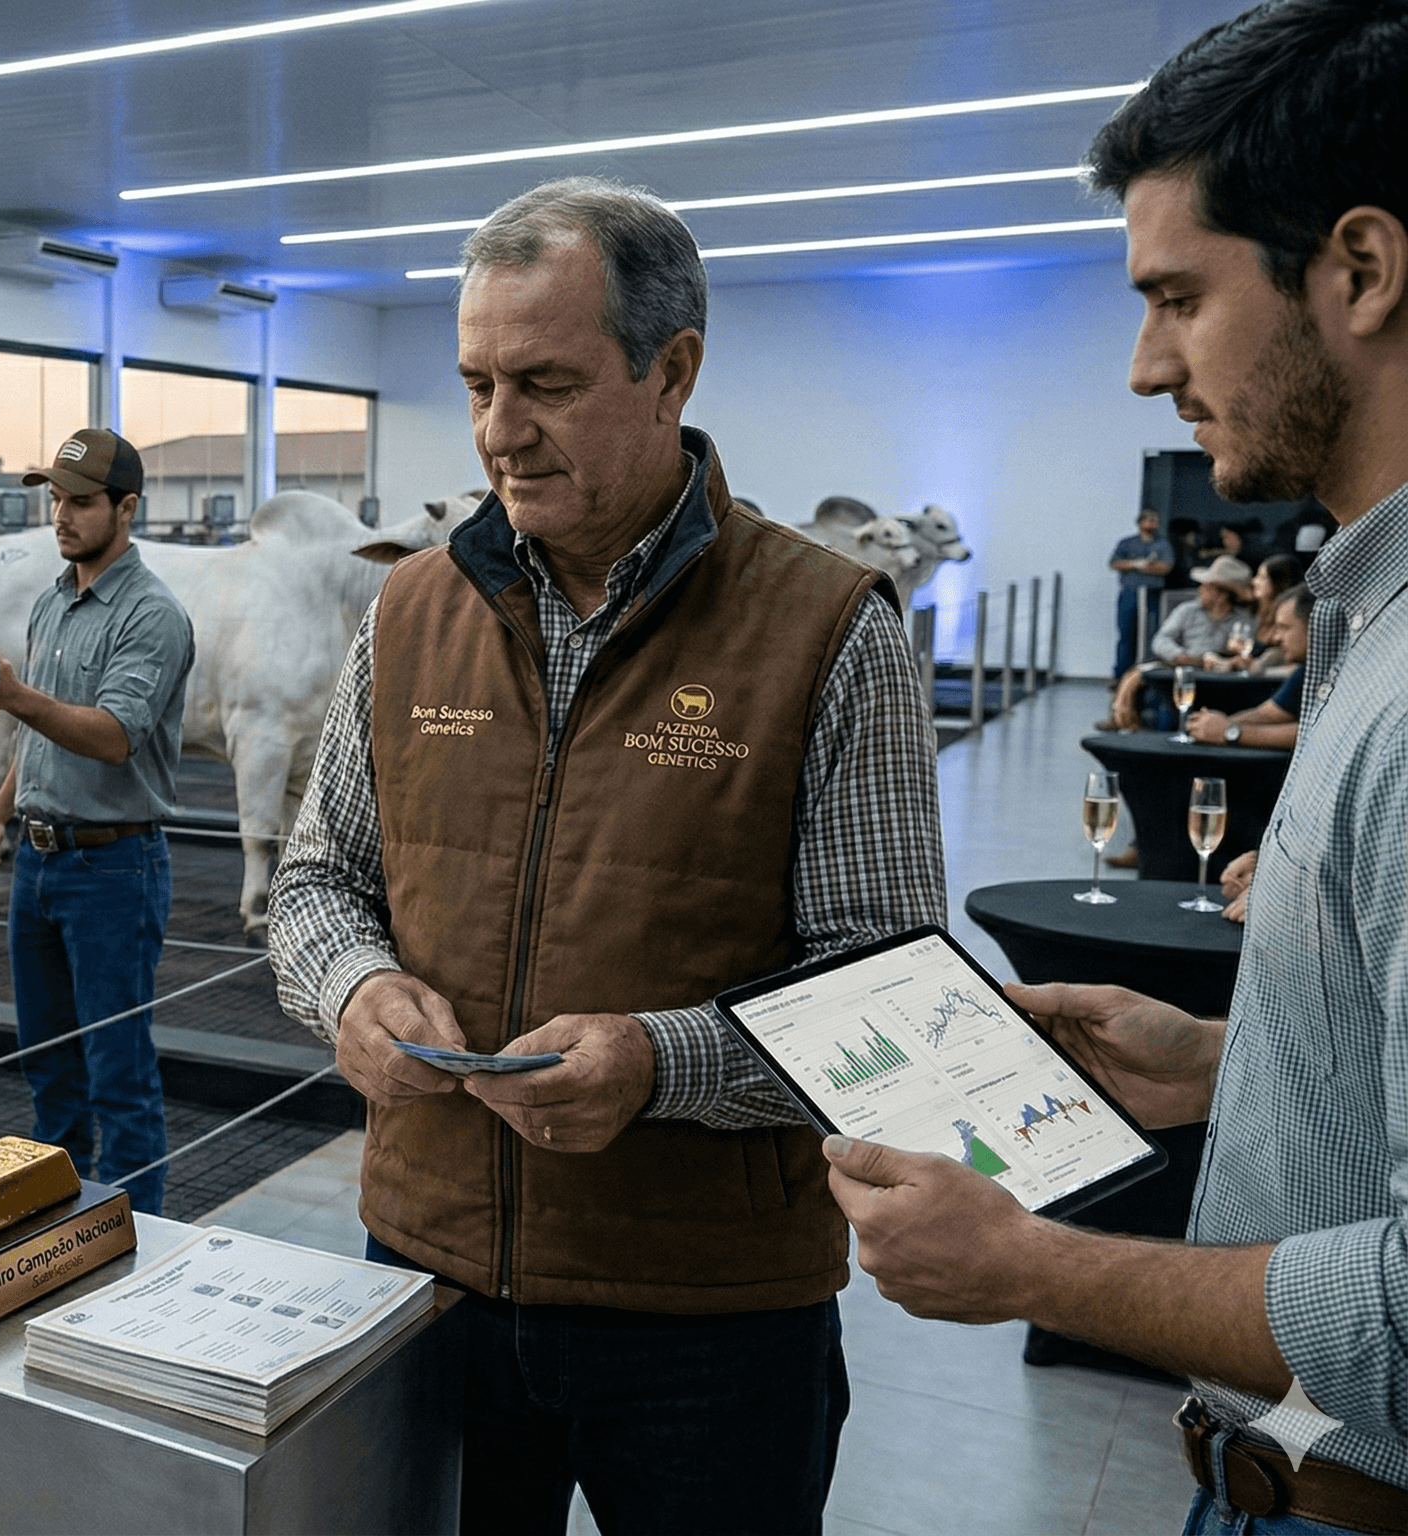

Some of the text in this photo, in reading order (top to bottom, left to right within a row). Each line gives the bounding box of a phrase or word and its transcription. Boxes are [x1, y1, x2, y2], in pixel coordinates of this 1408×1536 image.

[411, 705, 493, 720] Bom Sucesso
[420, 721, 475, 735] Genetics
[655, 722, 720, 739] FAZENDA
[624, 732, 749, 758] BOM SUCESSO
[648, 752, 717, 770] GENETICS
[75, 1208, 126, 1247] Nacional
